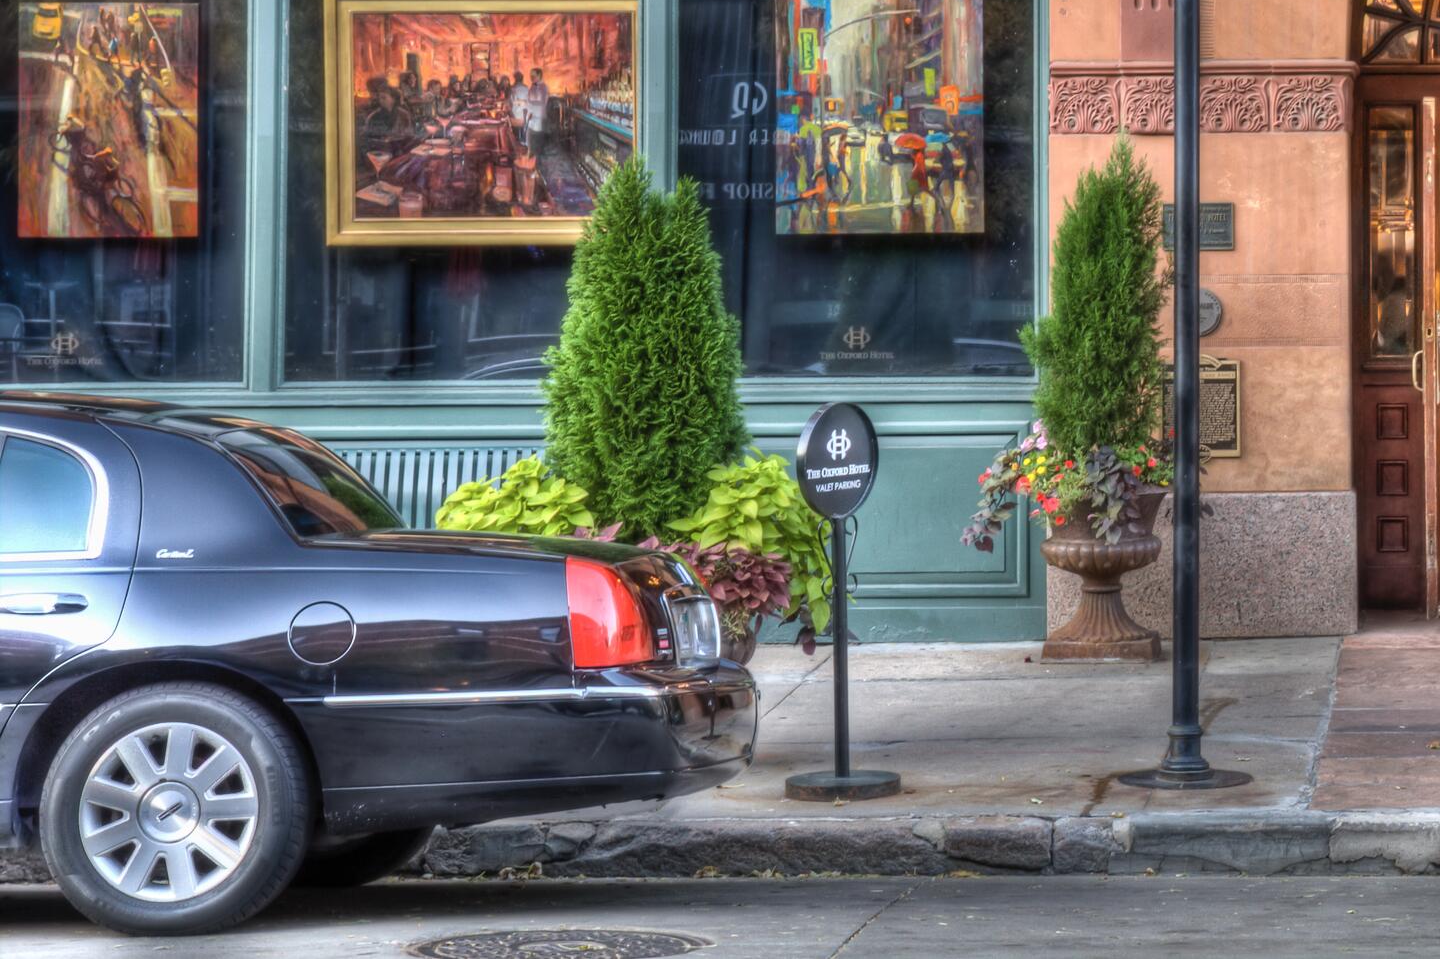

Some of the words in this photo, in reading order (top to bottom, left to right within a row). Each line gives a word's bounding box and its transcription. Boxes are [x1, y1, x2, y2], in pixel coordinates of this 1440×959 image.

[807, 468, 821, 479] THE
[821, 467, 849, 478] OXFORD
[849, 464, 871, 475] HOTEL
[816, 482, 834, 492] VALET
[834, 479, 861, 491] PARKING
